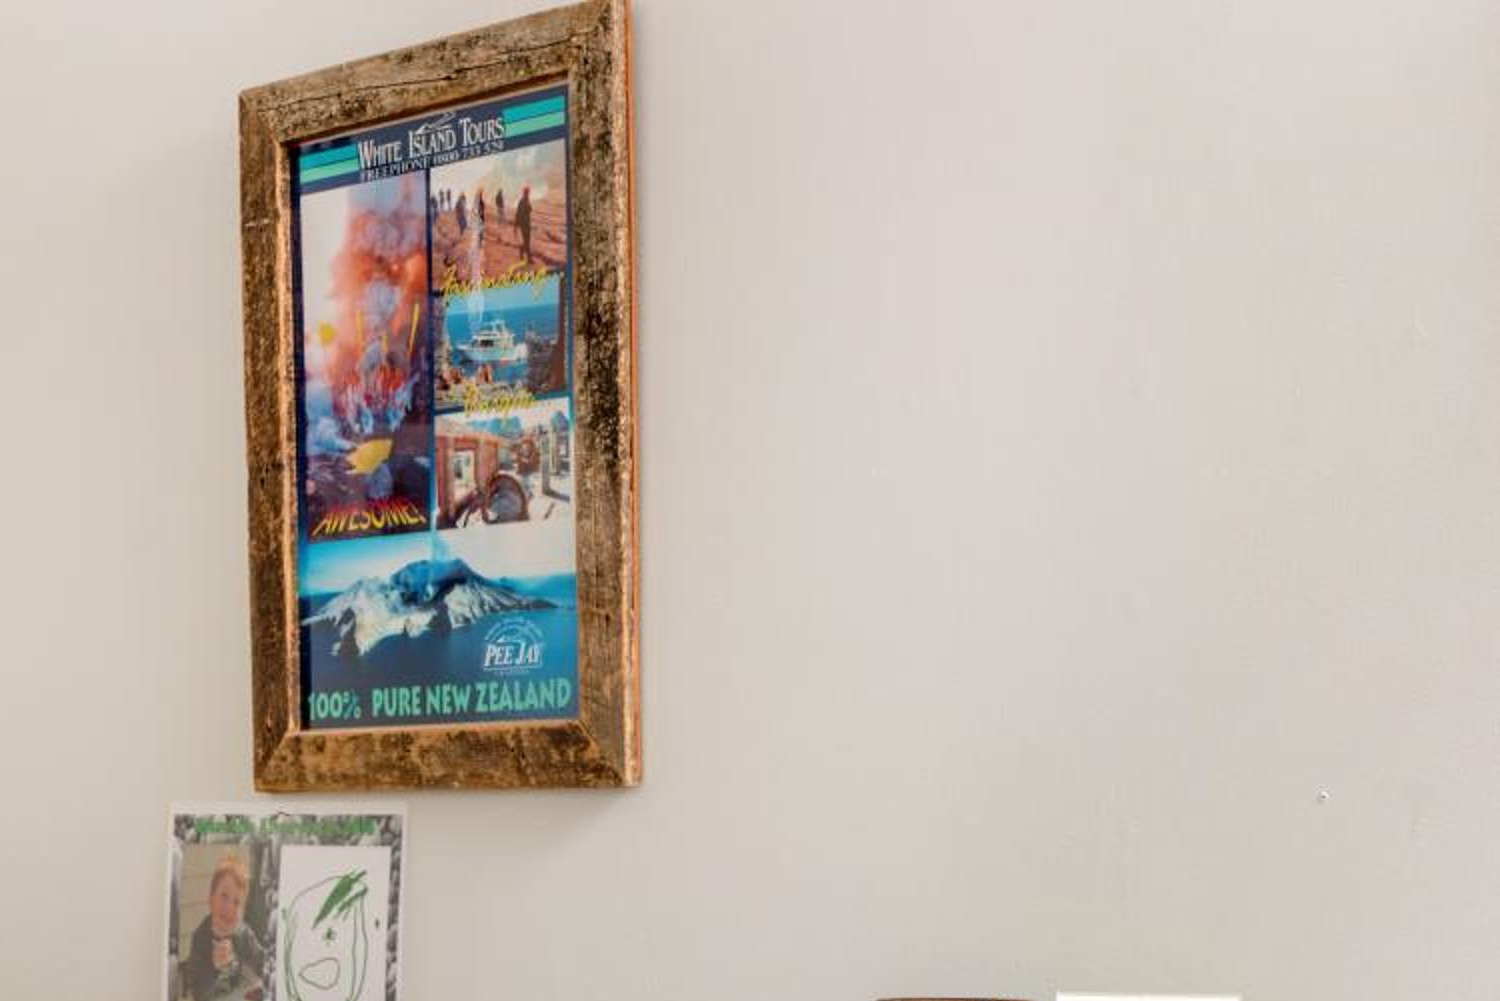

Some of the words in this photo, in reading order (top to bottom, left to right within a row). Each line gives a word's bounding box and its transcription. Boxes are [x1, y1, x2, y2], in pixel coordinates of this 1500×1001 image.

[409, 129, 457, 158] ISLAND
[459, 117, 505, 146] TOURS
[483, 644, 513, 667] PEE
[515, 640, 541, 665] JAY
[309, 688, 361, 720] 100%
[372, 686, 421, 717] PURE
[427, 682, 471, 715] NEW
[475, 678, 572, 713] ZEALAND
